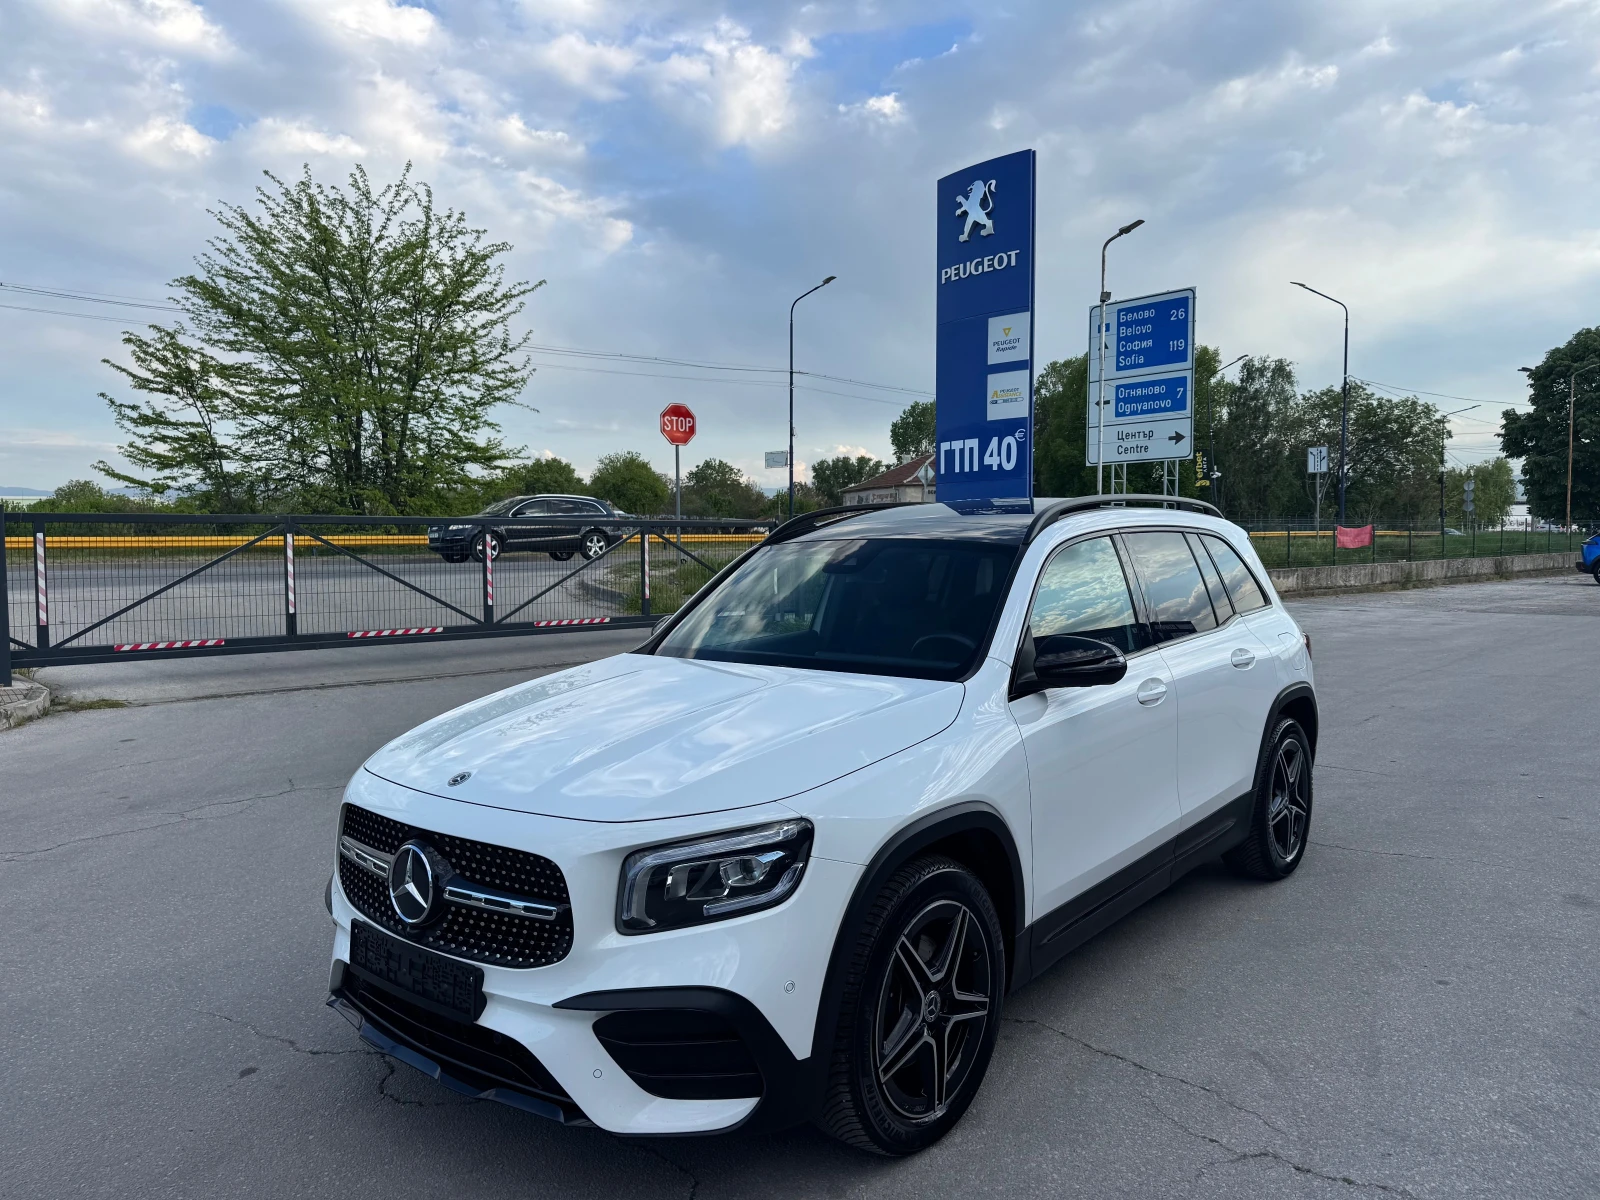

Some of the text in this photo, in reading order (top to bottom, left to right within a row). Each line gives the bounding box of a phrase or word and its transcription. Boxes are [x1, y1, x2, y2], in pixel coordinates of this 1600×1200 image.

[941, 249, 1020, 285] PEUGEOT
[1120, 308, 1185, 322] Белово 26
[1120, 324, 1152, 337] Belovo
[992, 338, 1021, 347] PEUGEOT
[1119, 339, 1185, 352] София 119
[1119, 355, 1144, 366] Sofia
[1118, 385, 1184, 399] Огняново 7
[1118, 399, 1172, 415] Ognyanovo
[664, 415, 693, 432] STOP
[1117, 429, 1154, 443] Център
[940, 438, 979, 474] ГТП
[1117, 444, 1149, 455] Centre
[1195, 451, 1203, 479] efbet
[864, 1083, 906, 1141] MICHELIN
